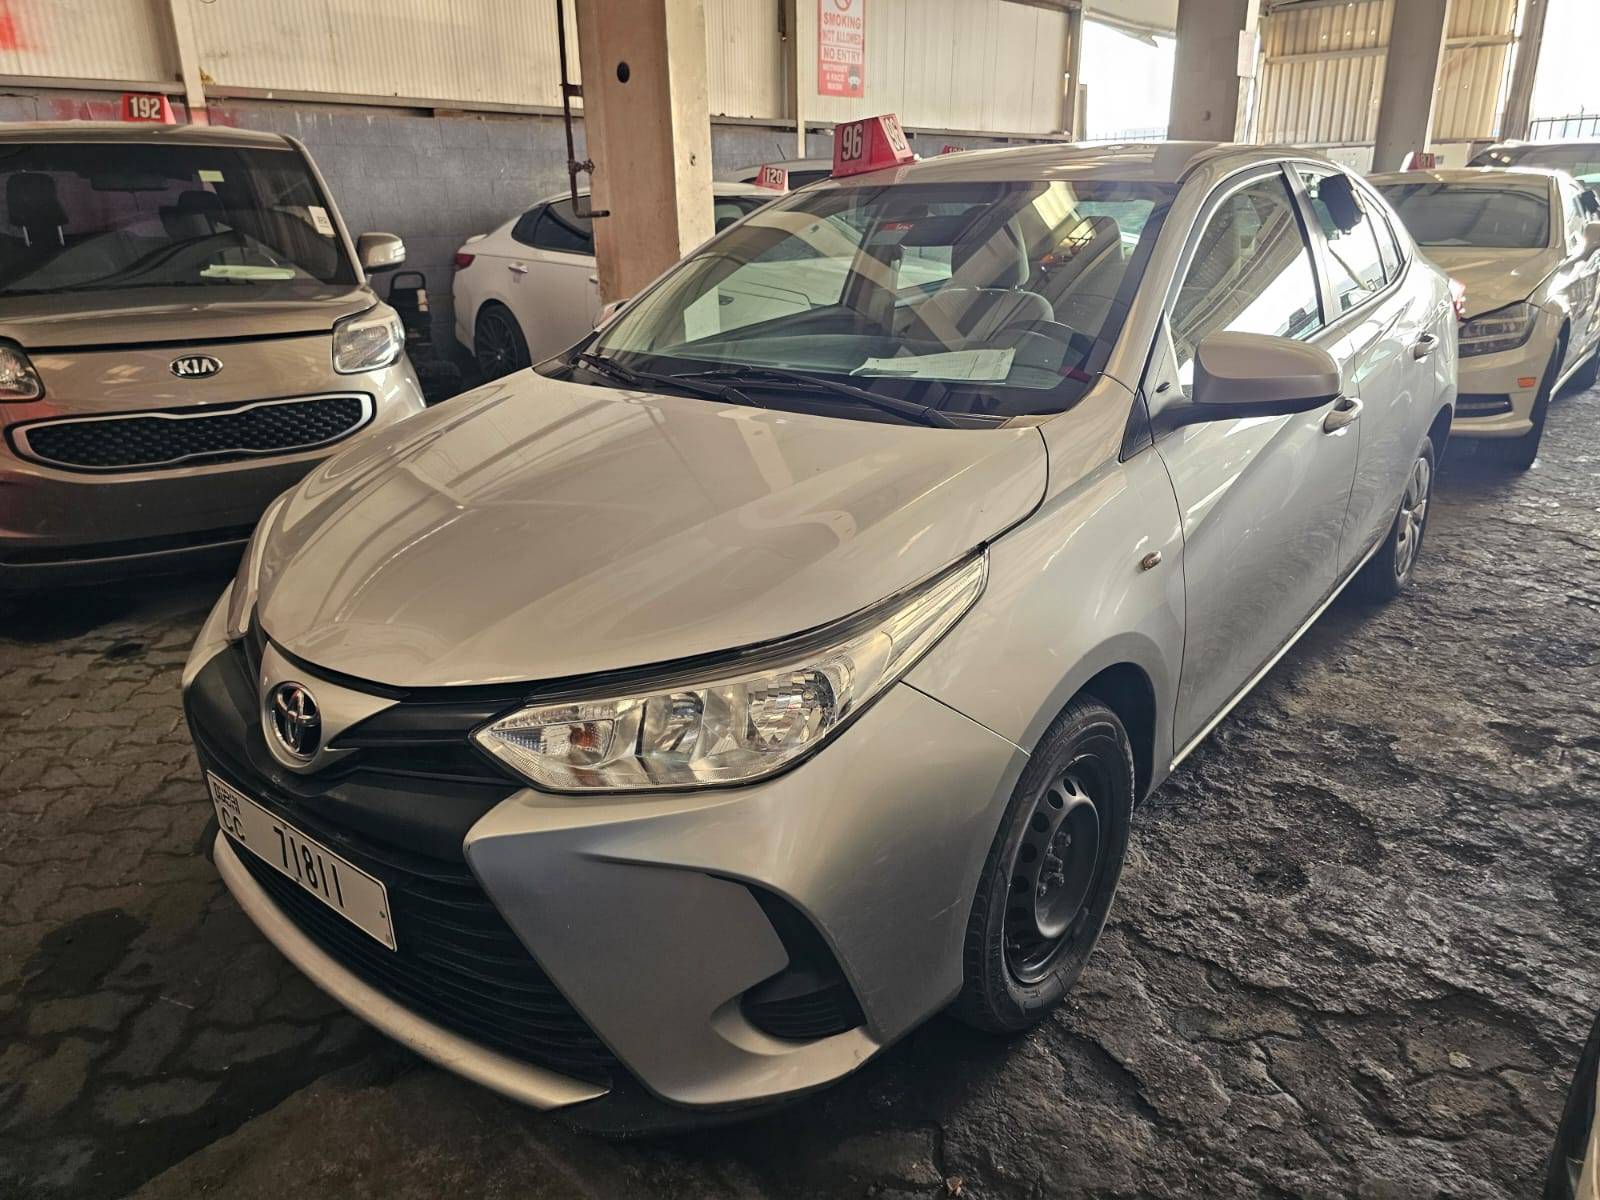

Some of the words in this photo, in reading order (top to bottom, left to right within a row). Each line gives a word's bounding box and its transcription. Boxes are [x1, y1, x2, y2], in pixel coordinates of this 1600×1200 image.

[823, 12, 862, 30] SMOKING
[822, 29, 834, 43] NOT
[836, 31, 862, 46] ALLOWED
[823, 47, 835, 60] NO
[837, 49, 861, 64] ENTRY
[129, 96, 161, 119] 192
[841, 123, 863, 160] 96
[765, 168, 784, 184] 120
[177, 359, 215, 375] KIA
[221, 806, 246, 841] CC
[272, 825, 345, 909] 71811
